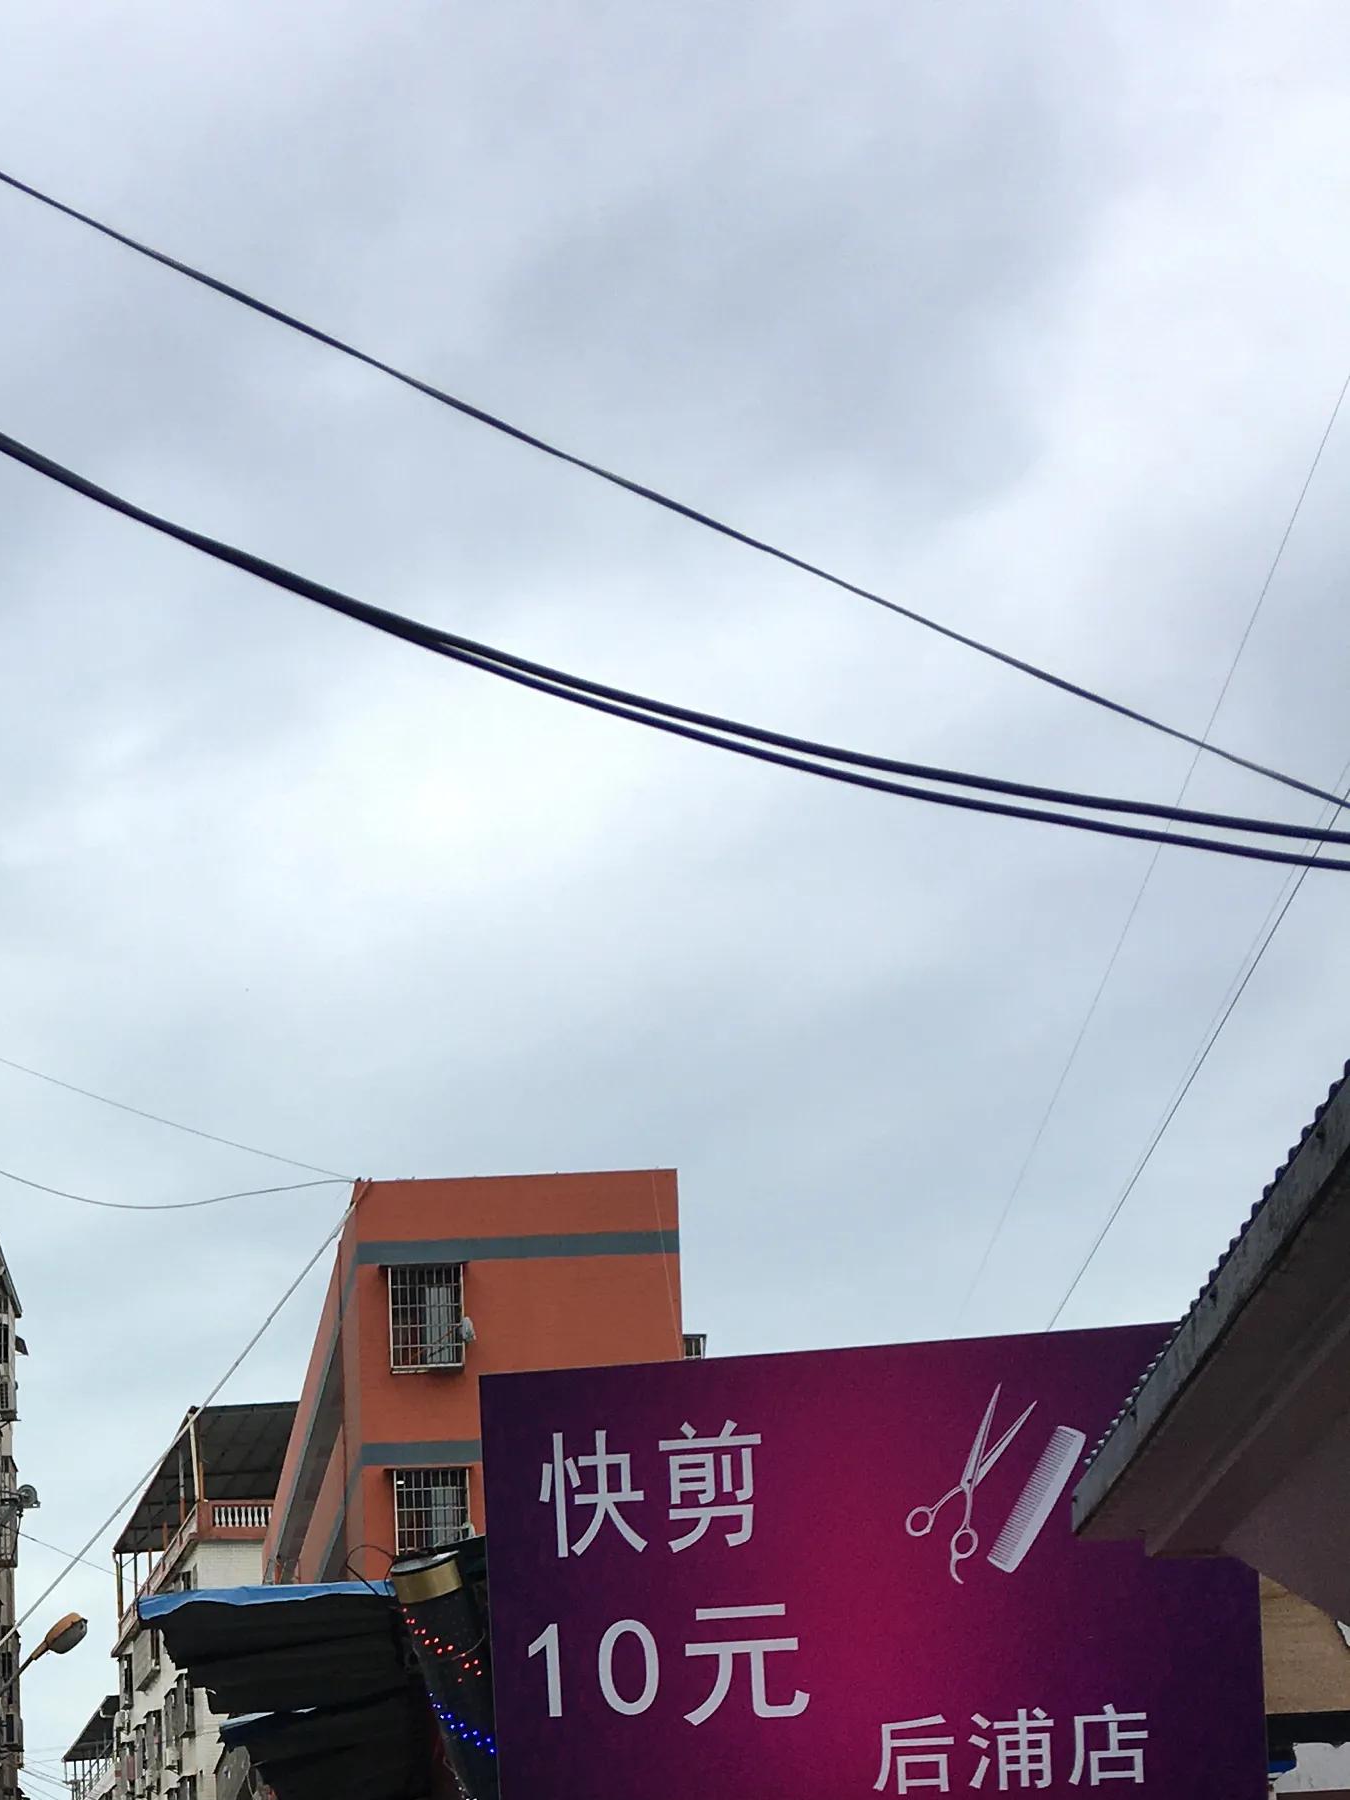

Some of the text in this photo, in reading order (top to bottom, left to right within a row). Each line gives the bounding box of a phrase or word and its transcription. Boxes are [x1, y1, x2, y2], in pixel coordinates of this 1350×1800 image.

[539, 1419, 762, 1558] 快剪
[526, 1603, 811, 1727] 10元
[872, 1703, 1149, 1796] 后浦店
